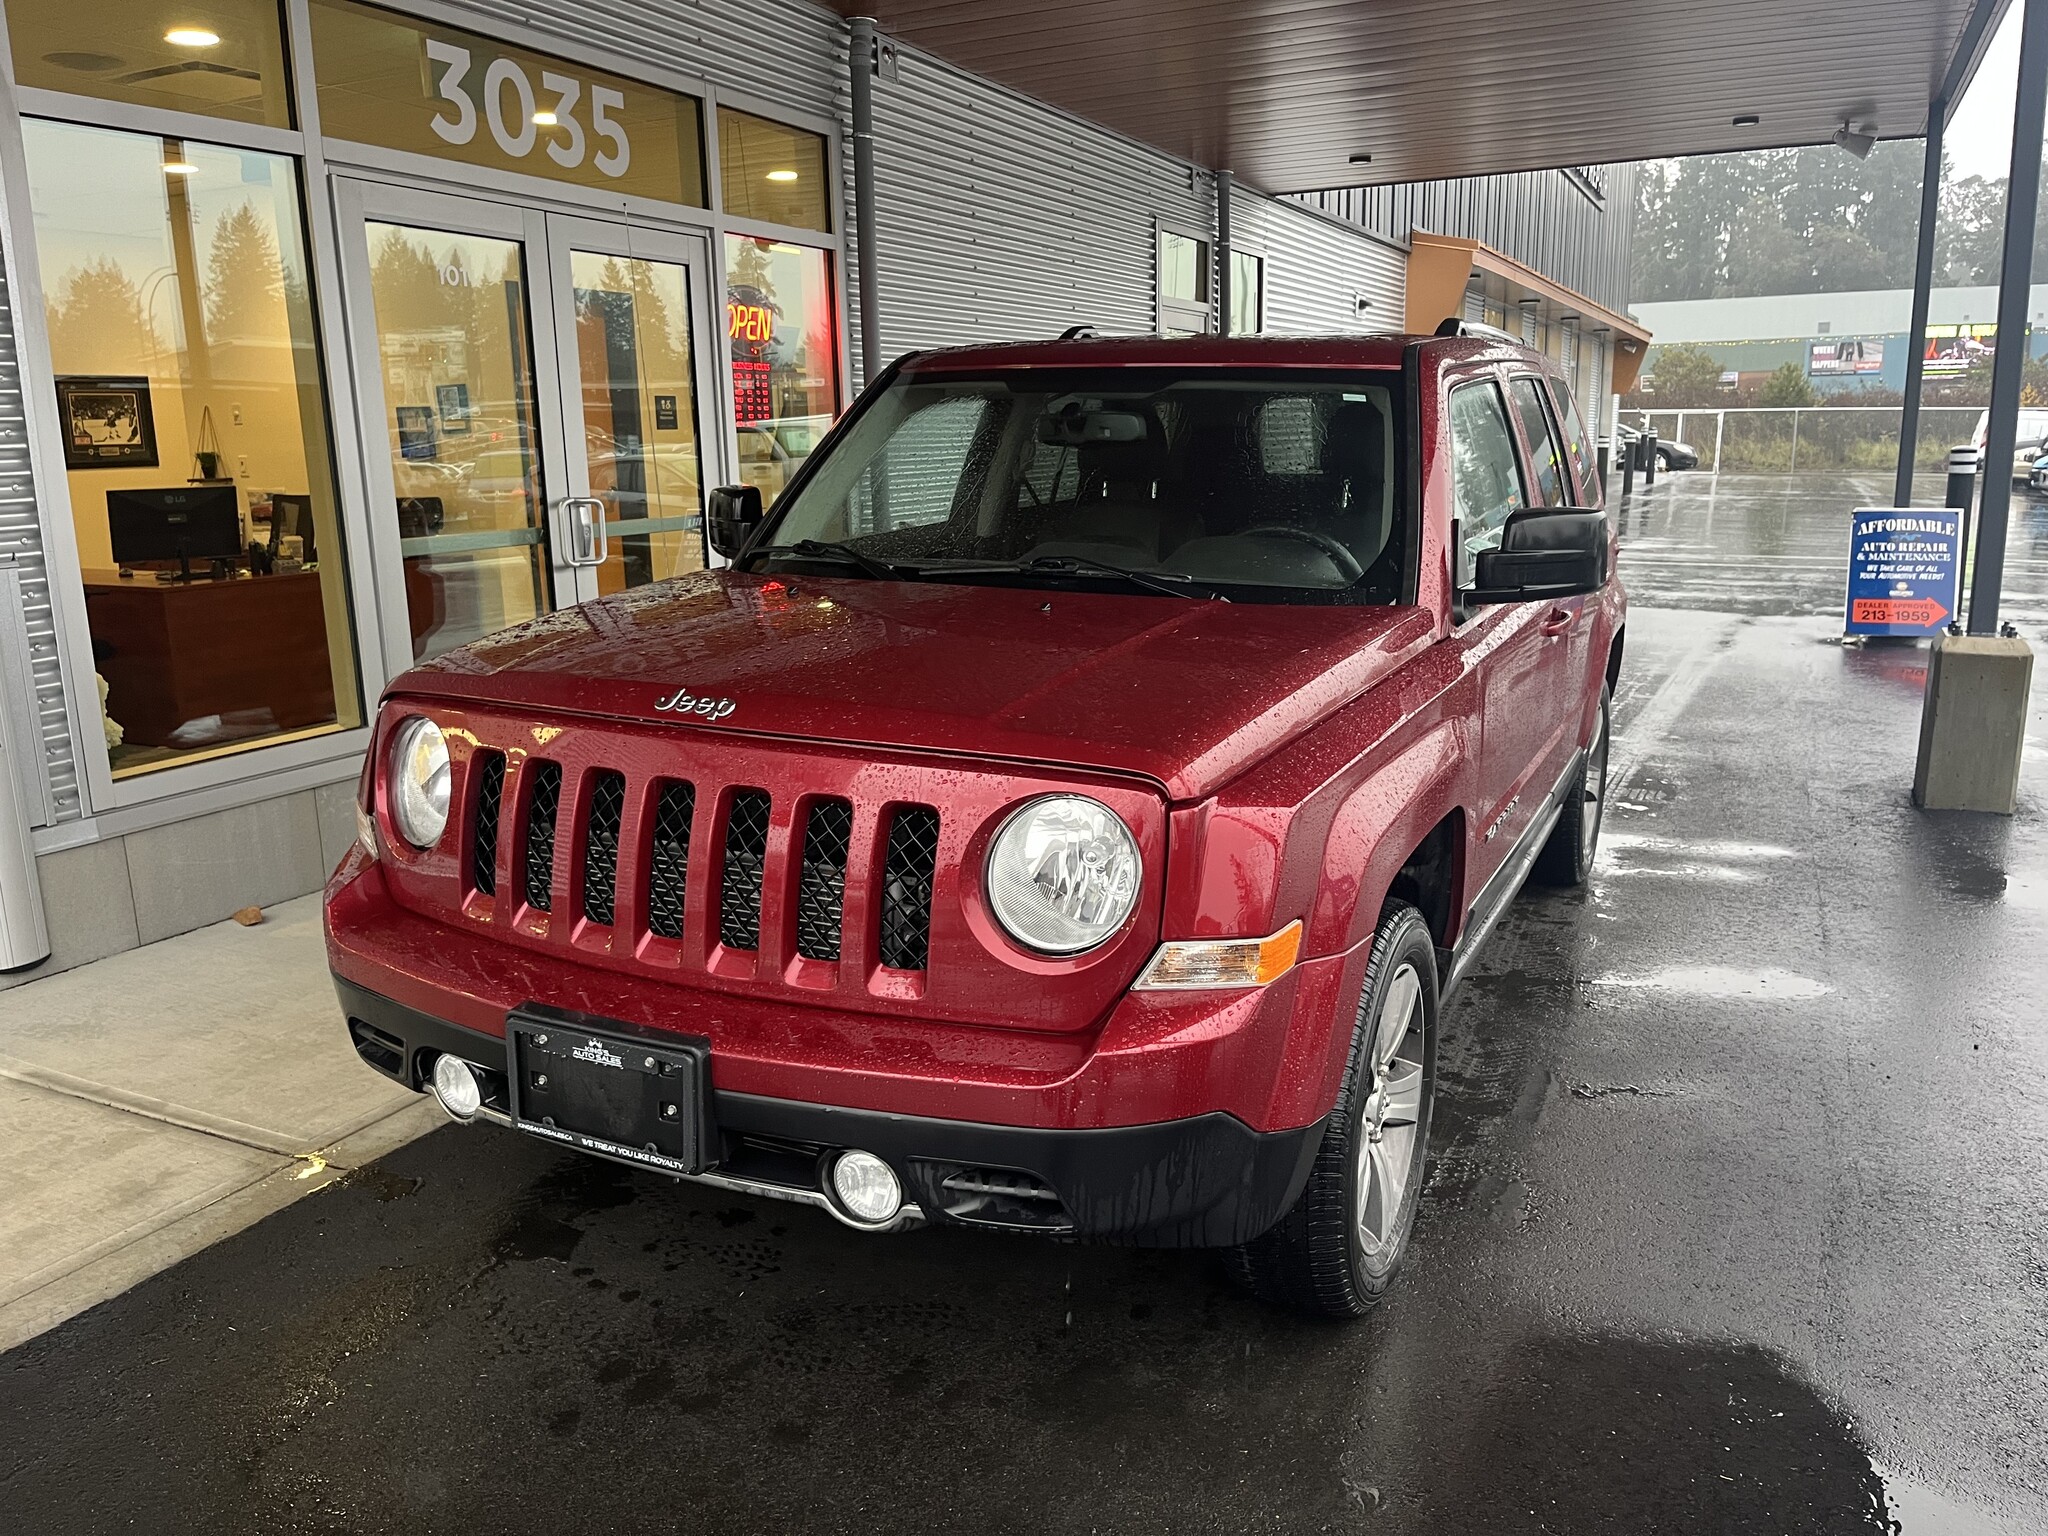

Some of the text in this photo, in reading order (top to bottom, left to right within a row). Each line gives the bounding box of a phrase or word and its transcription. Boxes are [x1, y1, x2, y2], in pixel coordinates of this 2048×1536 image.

[426, 38, 630, 177] 3035
[437, 265, 468, 287] 101
[175, 495, 187, 503] LG
[1857, 518, 1956, 537] AFFORDABLE
[1861, 542, 1948, 552] AUTO REPAIR
[1856, 552, 1951, 562] & MAINTENANCE
[1861, 610, 1931, 621] 213-1959
[654, 688, 736, 721] Jeep
[572, 1050, 621, 1065] AUTO SALES
[581, 1138, 594, 1149] WE
[594, 1141, 617, 1153] TREAT
[617, 1147, 634, 1158] YOU
[634, 1150, 650, 1162] LIKE
[650, 1155, 684, 1170] ROYALTY
